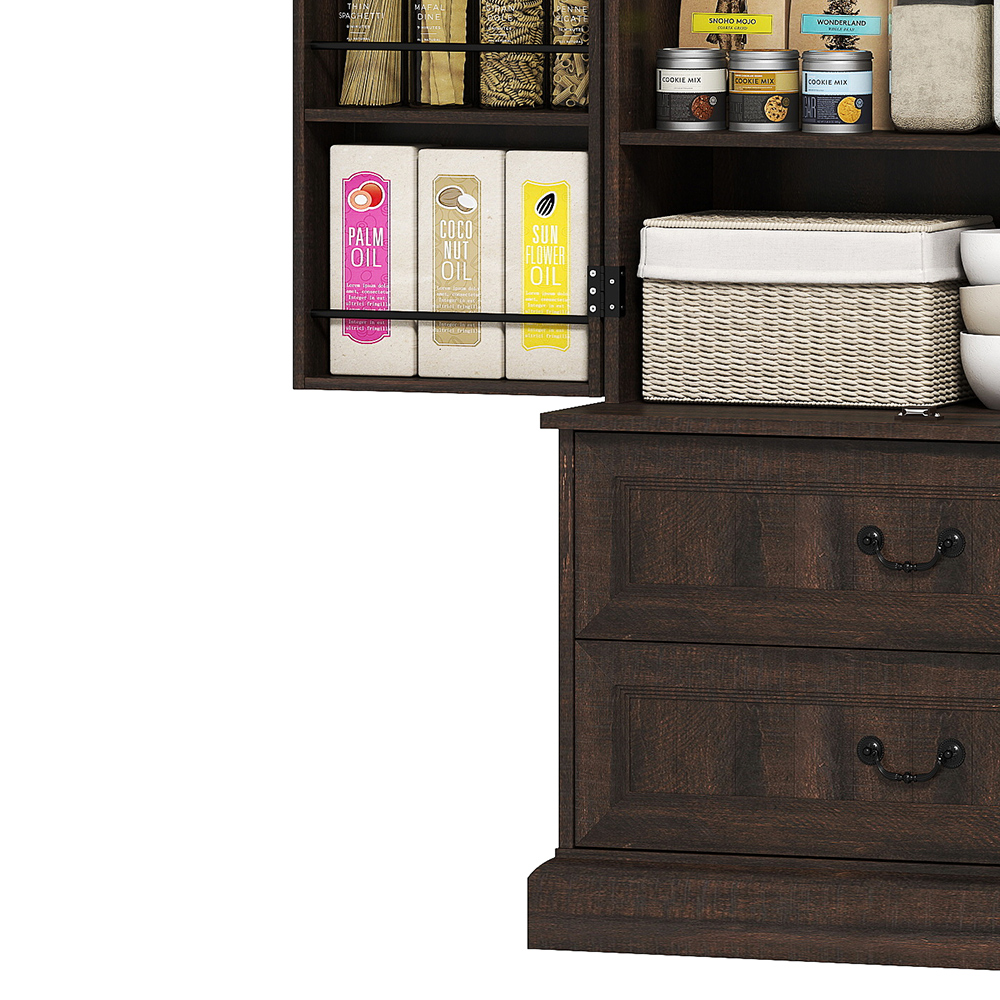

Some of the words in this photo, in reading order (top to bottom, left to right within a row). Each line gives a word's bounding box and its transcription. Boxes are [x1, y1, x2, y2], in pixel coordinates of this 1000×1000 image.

[338, 12, 384, 20] SPAGHETTI
[347, 2, 370, 10] THIN
[556, 5, 588, 13] PENNE
[817, 19, 867, 27] WONDERLAND
[348, 227, 384, 247] PALM
[440, 220, 473, 240] COCO
[532, 224, 558, 244] SUN
[351, 248, 382, 268] OIL
[444, 240, 469, 260] NUT
[526, 245, 565, 265] FLOWER
[441, 261, 472, 281] OIL
[530, 266, 561, 286] OIL
